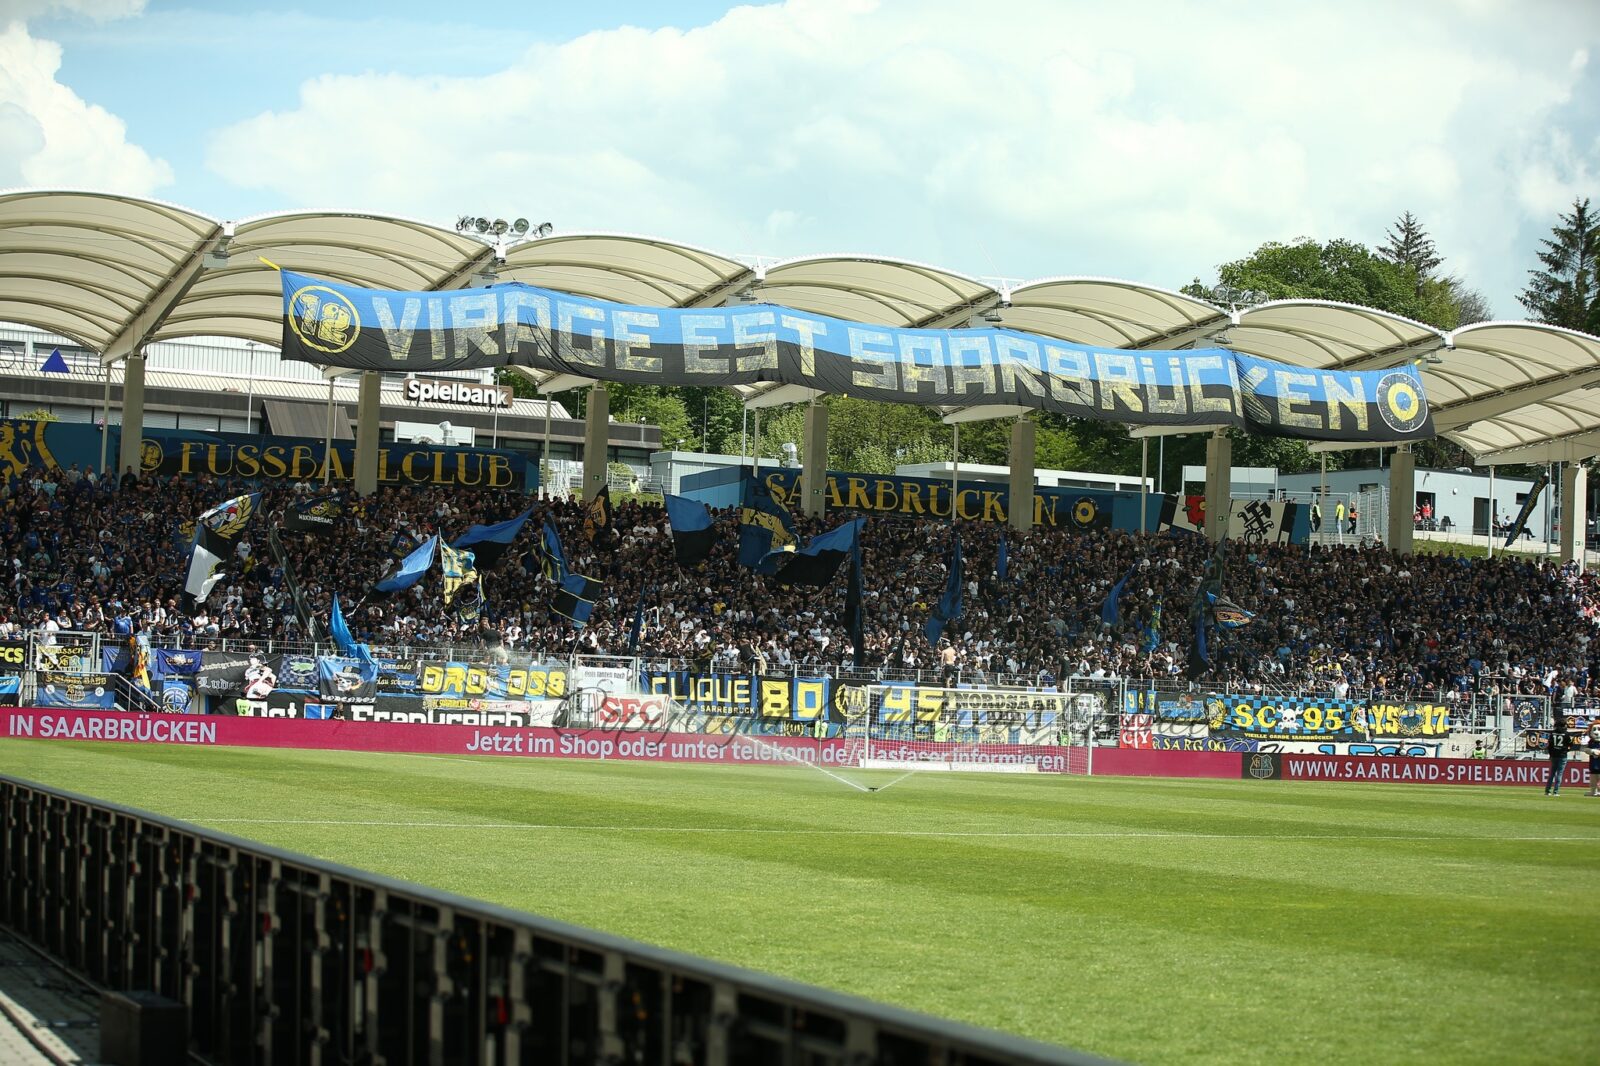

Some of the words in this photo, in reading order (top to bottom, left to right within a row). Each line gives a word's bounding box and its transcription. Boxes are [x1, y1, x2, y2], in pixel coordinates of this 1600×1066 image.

[372, 291, 663, 373] VIRAGE
[680, 311, 828, 377] EST
[408, 380, 509, 405] Spielbank
[178, 441, 513, 487] FUSSBALCLUB
[766, 472, 1060, 527] SAARBRÜCKN
[652, 676, 750, 704] CLIQUE
[955, 692, 1057, 711] NORDSAAR
[9, 714, 34, 736] IN
[40, 714, 216, 743] SAARBRÜCKEN
[1233, 703, 1277, 729] SC
[1302, 706, 1344, 731] 95
[1371, 704, 1401, 735] YS
[1421, 704, 1448, 735] 17
[466, 730, 523, 753] Jetzt
[528, 732, 555, 754] im
[559, 733, 613, 760] Shop
[618, 736, 667, 758] oder
[671, 742, 728, 761] unter
[952, 747, 1065, 771] informieren
[1552, 734, 1564, 747] 12
[1288, 759, 1591, 784] WWW.SAARLAND-SPIELBANKE.DE
